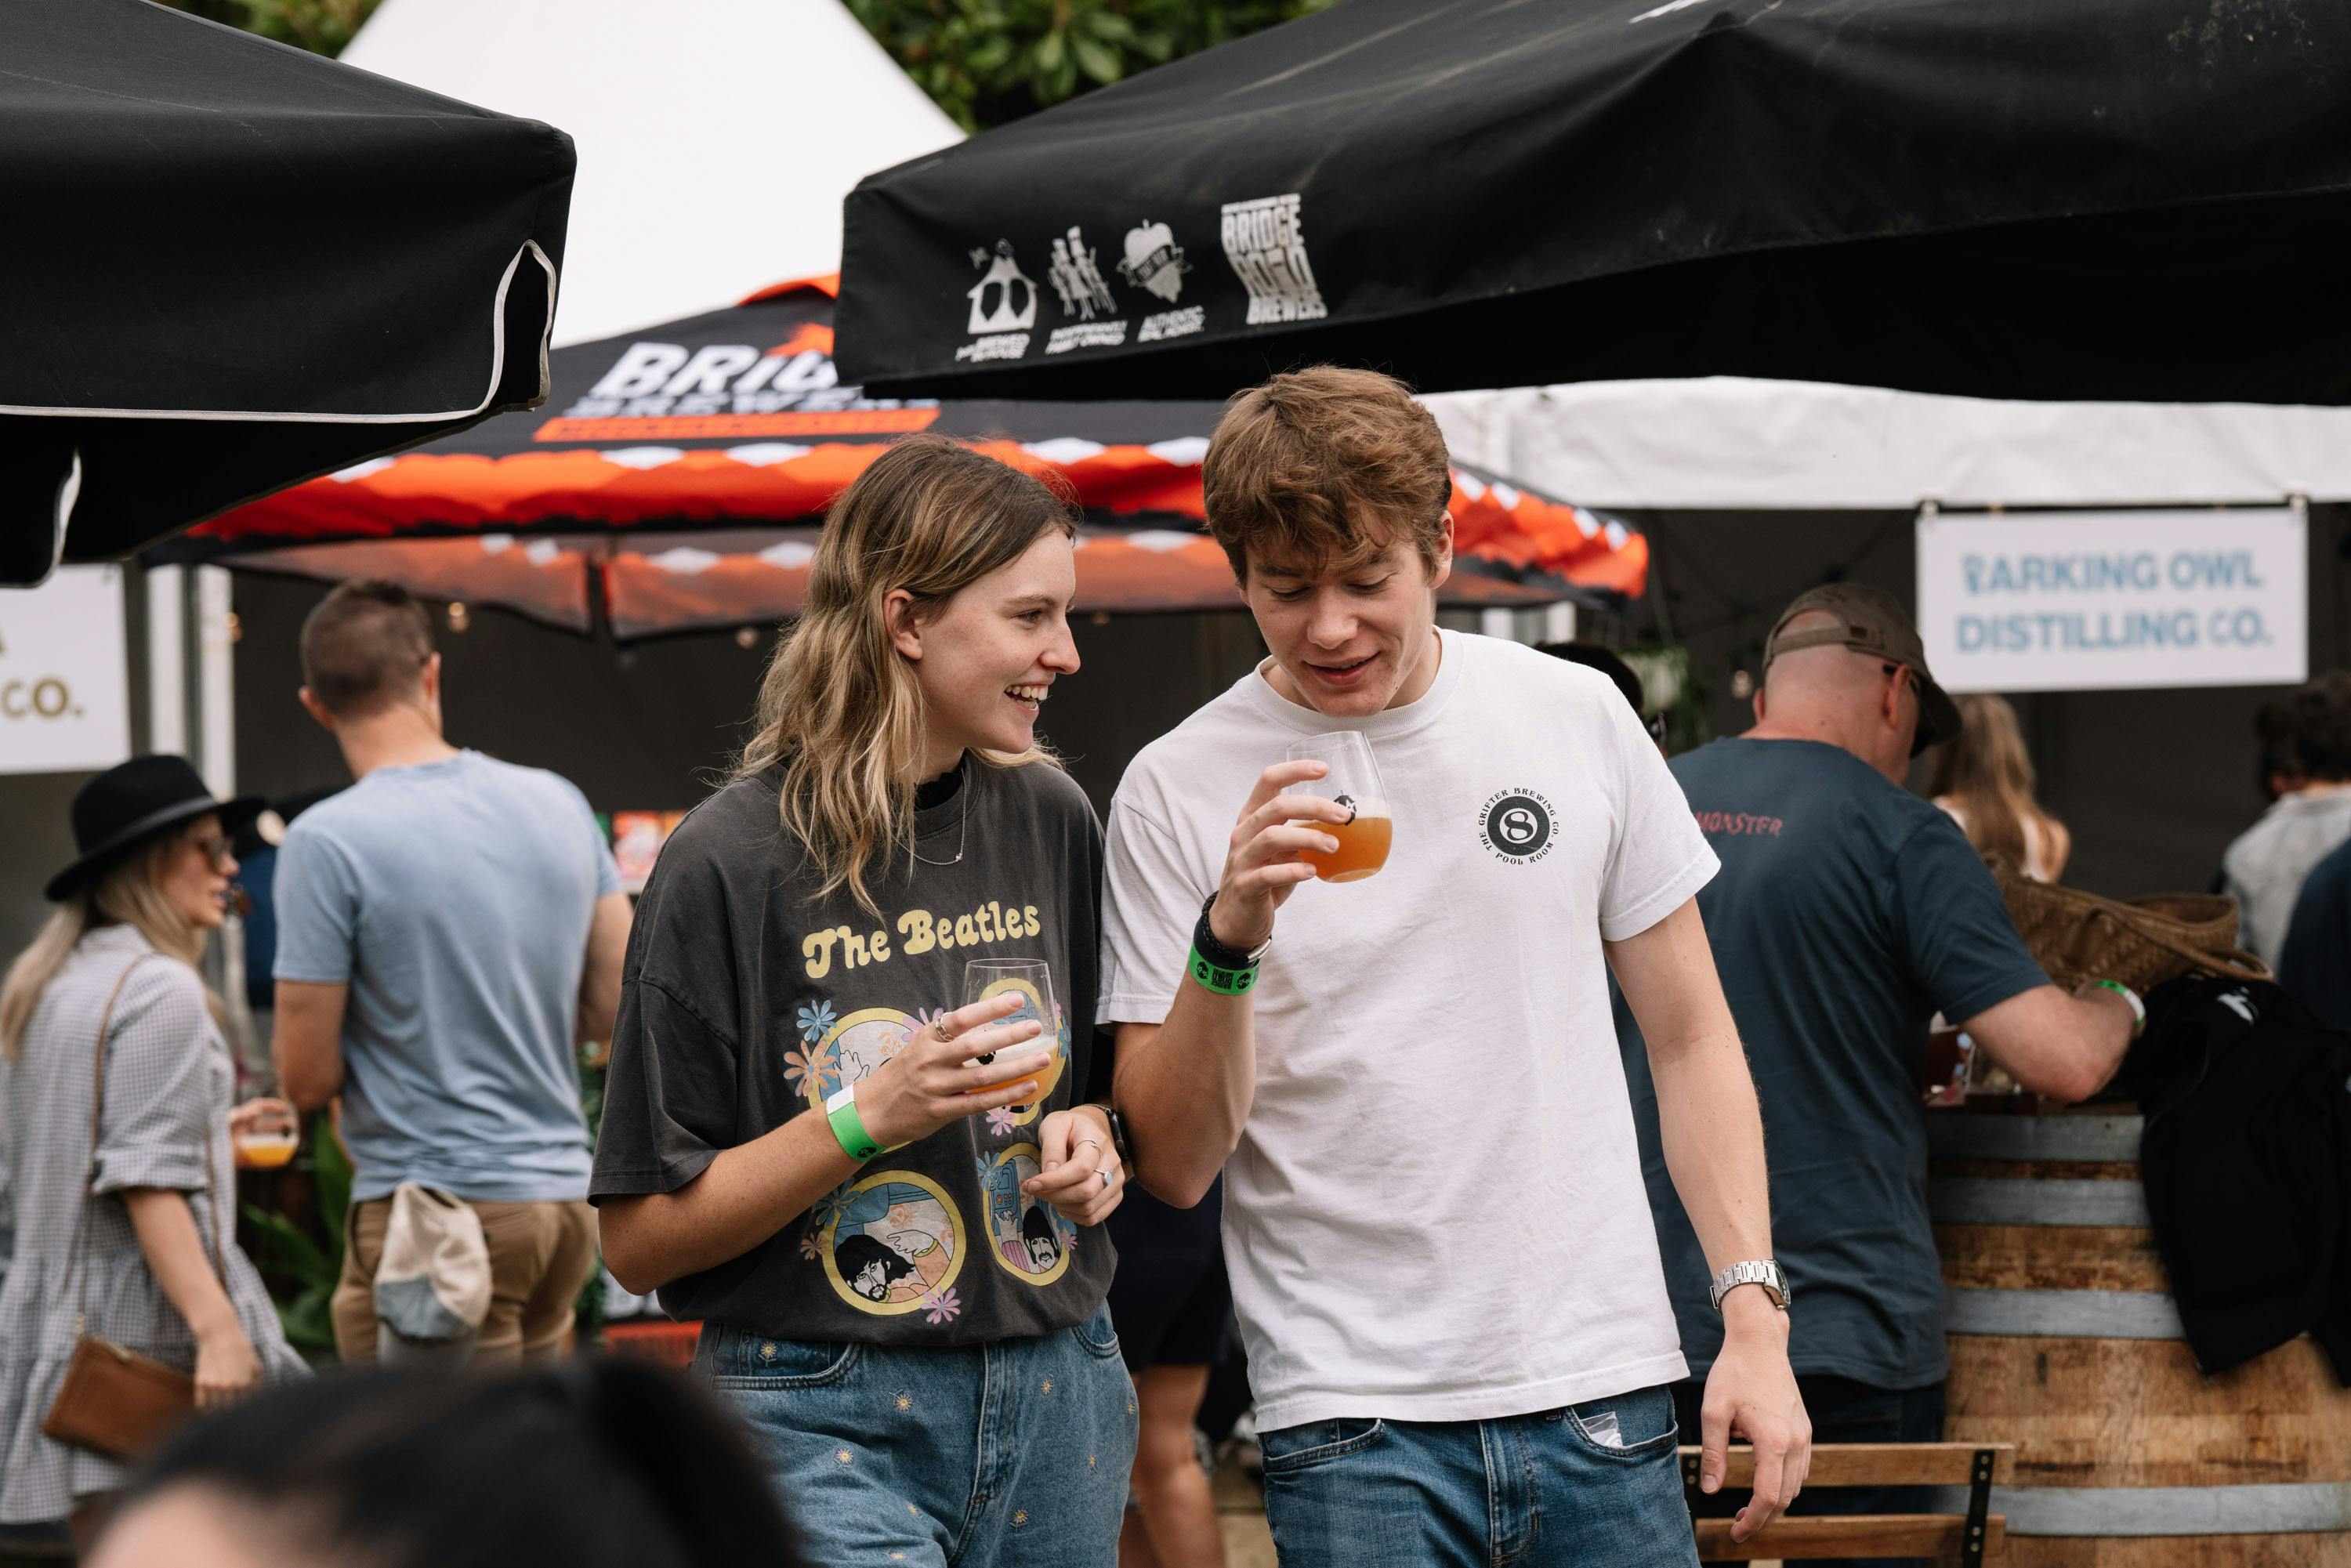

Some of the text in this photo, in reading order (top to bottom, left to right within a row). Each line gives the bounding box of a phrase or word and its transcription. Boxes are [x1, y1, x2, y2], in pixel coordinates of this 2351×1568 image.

[1221, 203, 1304, 255] BRIDGE
[589, 342, 839, 394] BRIG
[2168, 550, 2263, 589] OWL
[1956, 607, 2275, 651] DISTILLING CO.
[2, 677, 84, 720] CO.
[1478, 789, 1509, 826] GRIFTER
[1514, 788, 1556, 817] BREWING
[1479, 831, 1492, 851] THE
[1504, 810, 1534, 842] 8
[1495, 842, 1553, 865] POOL ROOM
[802, 900, 1041, 979] The Beatles
